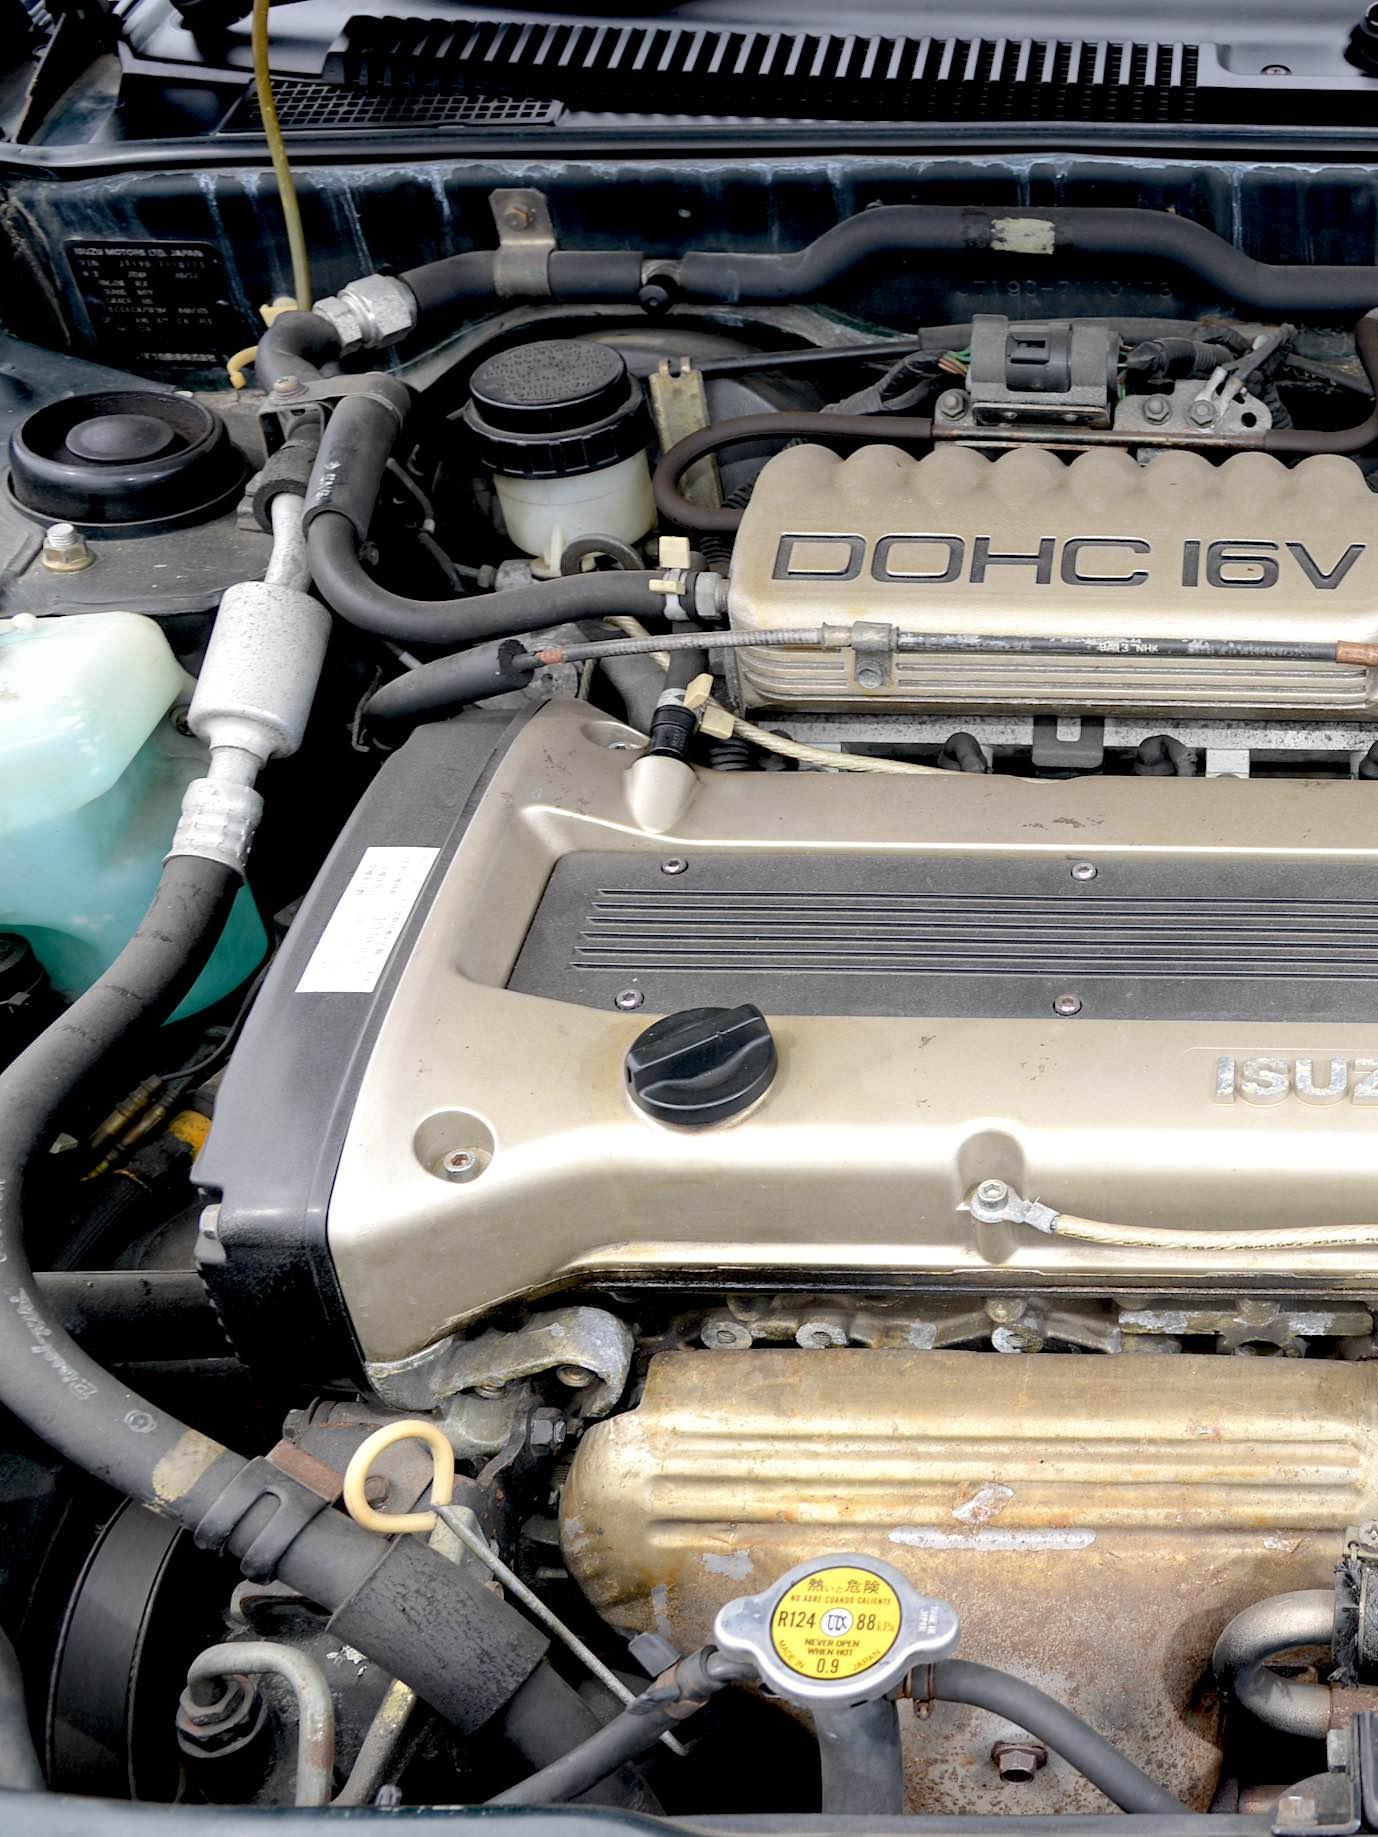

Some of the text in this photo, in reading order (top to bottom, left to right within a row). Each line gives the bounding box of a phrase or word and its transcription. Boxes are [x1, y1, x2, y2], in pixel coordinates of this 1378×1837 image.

[771, 533, 1368, 590] DOHC 16V
[778, 1611, 816, 1629] R124
[805, 1639, 859, 1648] NEVER OPEN
[807, 1648, 853, 1657] WHEN HOT
[816, 1658, 840, 1674] 0.9
